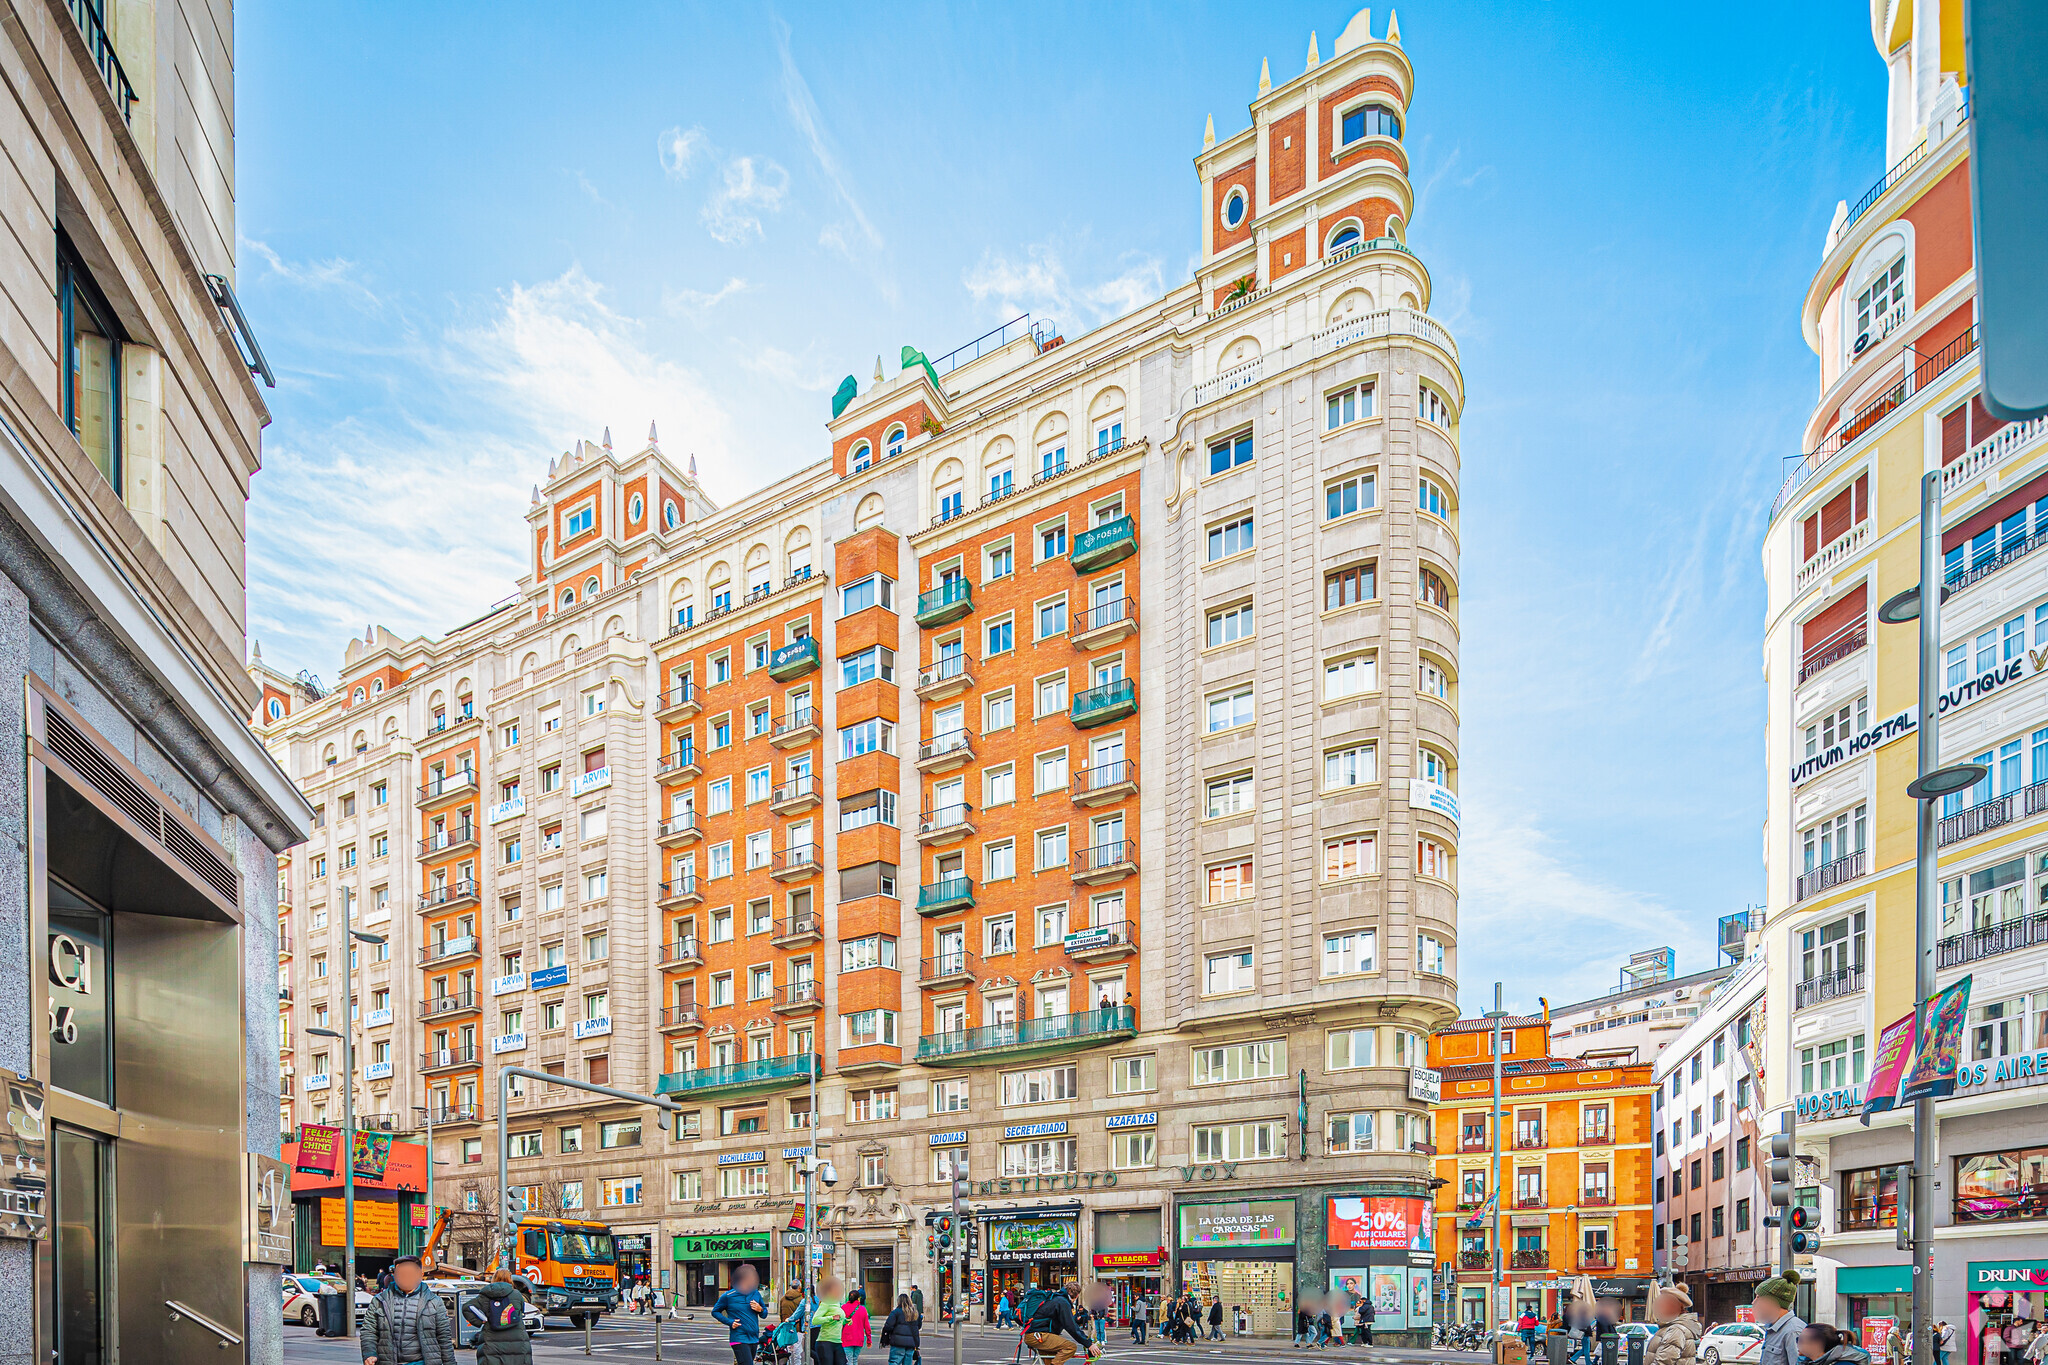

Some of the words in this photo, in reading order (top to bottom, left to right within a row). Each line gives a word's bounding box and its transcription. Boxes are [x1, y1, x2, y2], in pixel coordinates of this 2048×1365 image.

[1096, 526, 1122, 540] FOSSA
[1791, 746, 1844, 782] VITIUM
[1850, 712, 1917, 756] HOSTAL
[1939, 658, 2022, 712] OUTIQUE
[1414, 1070, 1440, 1084] ESCUELA
[1414, 1086, 1439, 1101] TURISMO
[1796, 1088, 1862, 1116] HOSTAL
[1108, 1113, 1155, 1127] AZAFATAS
[305, 1128, 333, 1138] FELIZ
[1006, 1122, 1066, 1137] SECRETARIADO
[931, 1132, 964, 1144] IDIOMAS
[303, 1142, 332, 1151] CHINO
[784, 1147, 812, 1158] TURISM
[718, 1152, 763, 1164] BACHILLERATO
[970, 1172, 1117, 1195] INSTITUTO
[1182, 1163, 1238, 1182] VOX
[728, 1203, 746, 1211] para
[1213, 1216, 1238, 1224] CASA
[1240, 1216, 1252, 1224] DE
[1255, 1214, 1274, 1223] LAS
[1352, 1212, 1405, 1230] -50%
[1212, 1224, 1260, 1234] CARCASAS
[687, 1240, 702, 1252] La
[704, 1239, 752, 1252] Toscana
[990, 1252, 1002, 1260] bar
[1002, 1252, 1012, 1260] de
[1012, 1251, 1032, 1260] tapas
[1034, 1250, 1074, 1259] restaurante
[1725, 1272, 1738, 1282] HOTEL
[1739, 1270, 1766, 1280] MAYORAZGO
[1978, 1269, 2031, 1282] DRUNI
